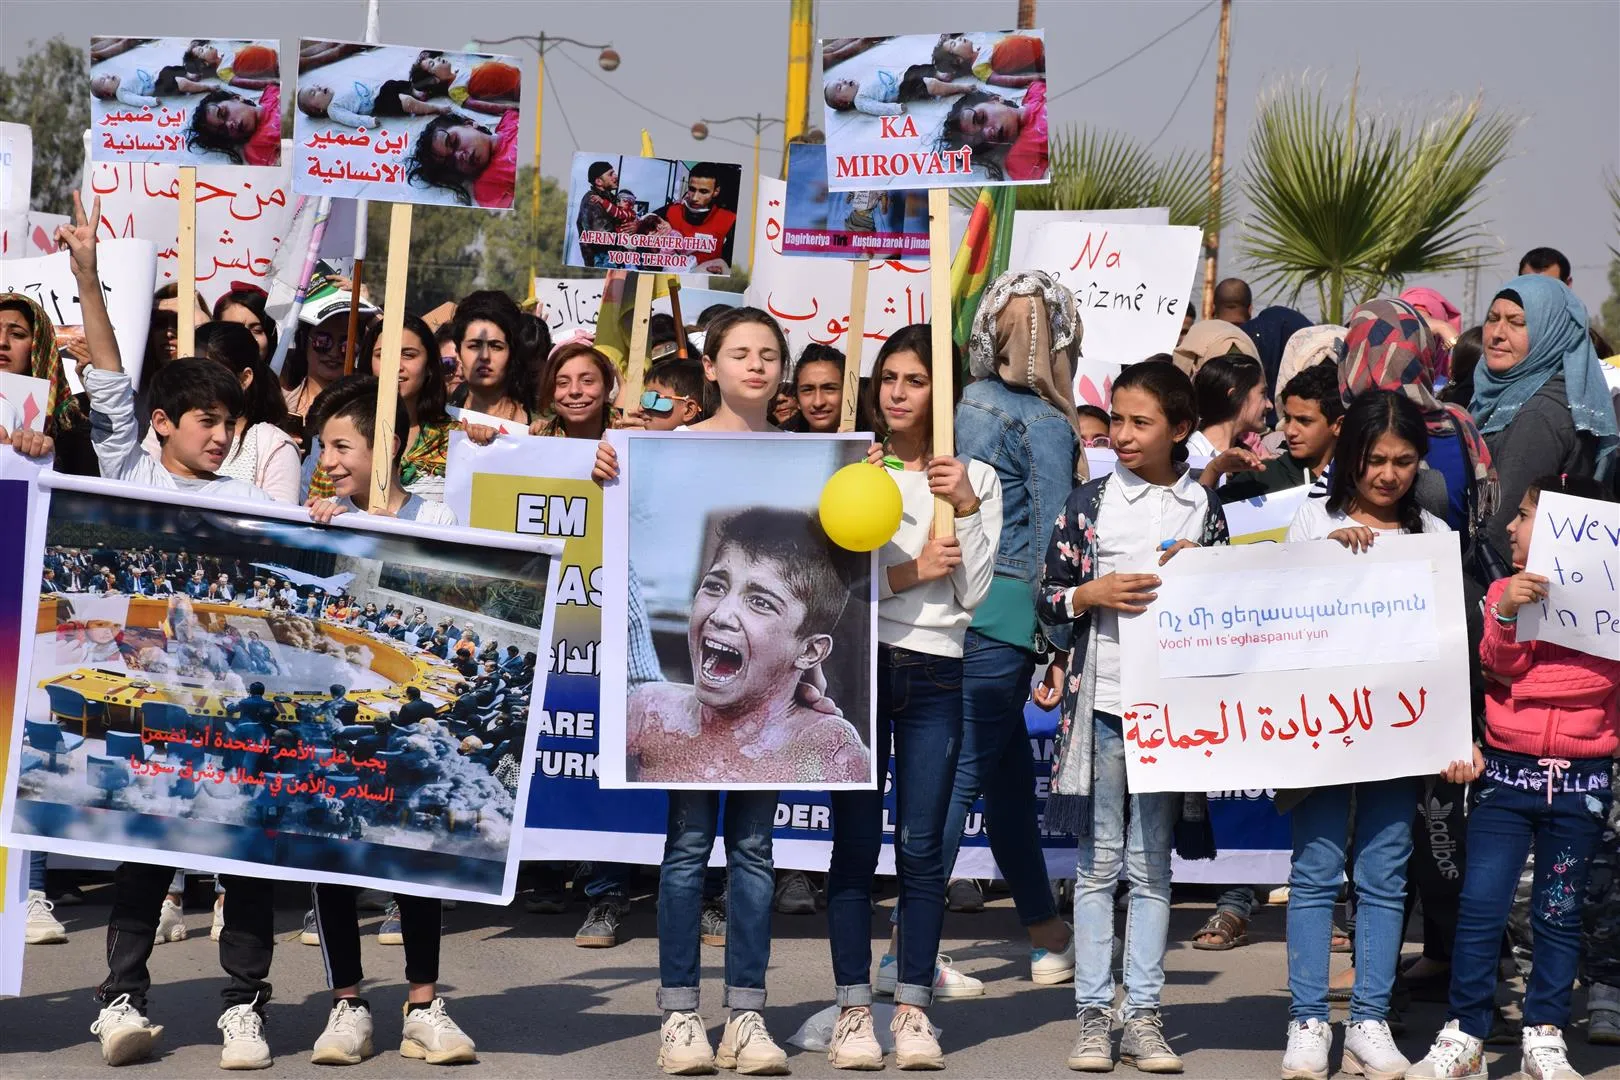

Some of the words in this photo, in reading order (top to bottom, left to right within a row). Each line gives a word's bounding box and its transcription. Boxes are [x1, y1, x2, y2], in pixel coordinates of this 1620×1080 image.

[99, 105, 153, 126] ضمير
[156, 108, 186, 127] اين
[879, 114, 919, 139] KA
[102, 132, 185, 154] الانسانية
[303, 127, 371, 149] ضمير
[374, 130, 409, 154] اين
[307, 156, 405, 184] الانسانية
[835, 145, 973, 178] MIROVATÎ
[579, 230, 616, 246] AFRIN
[617, 233, 630, 246] IS
[630, 234, 683, 250] GREATER
[684, 237, 717, 251] THAN
[882, 237, 903, 249] zarok
[1070, 231, 1121, 271] Na
[607, 250, 641, 265] YOUR
[642, 254, 688, 267] TERROR
[1157, 297, 1178, 315] re
[515, 493, 588, 537] EM
[1554, 557, 1583, 585] to
[1541, 598, 1577, 627] in
[1197, 636, 1212, 647] mi
[1258, 686, 1375, 750] للإبادة
[1390, 686, 1428, 728] لا
[191, 726, 210, 748] أن
[130, 754, 175, 776] سوريا
[319, 748, 350, 768] على
[352, 756, 388, 775] يجب
[228, 768, 266, 786] شمال
[269, 772, 283, 798] في
[339, 783, 395, 803] السلام
[1430, 821, 1459, 880] adidas
